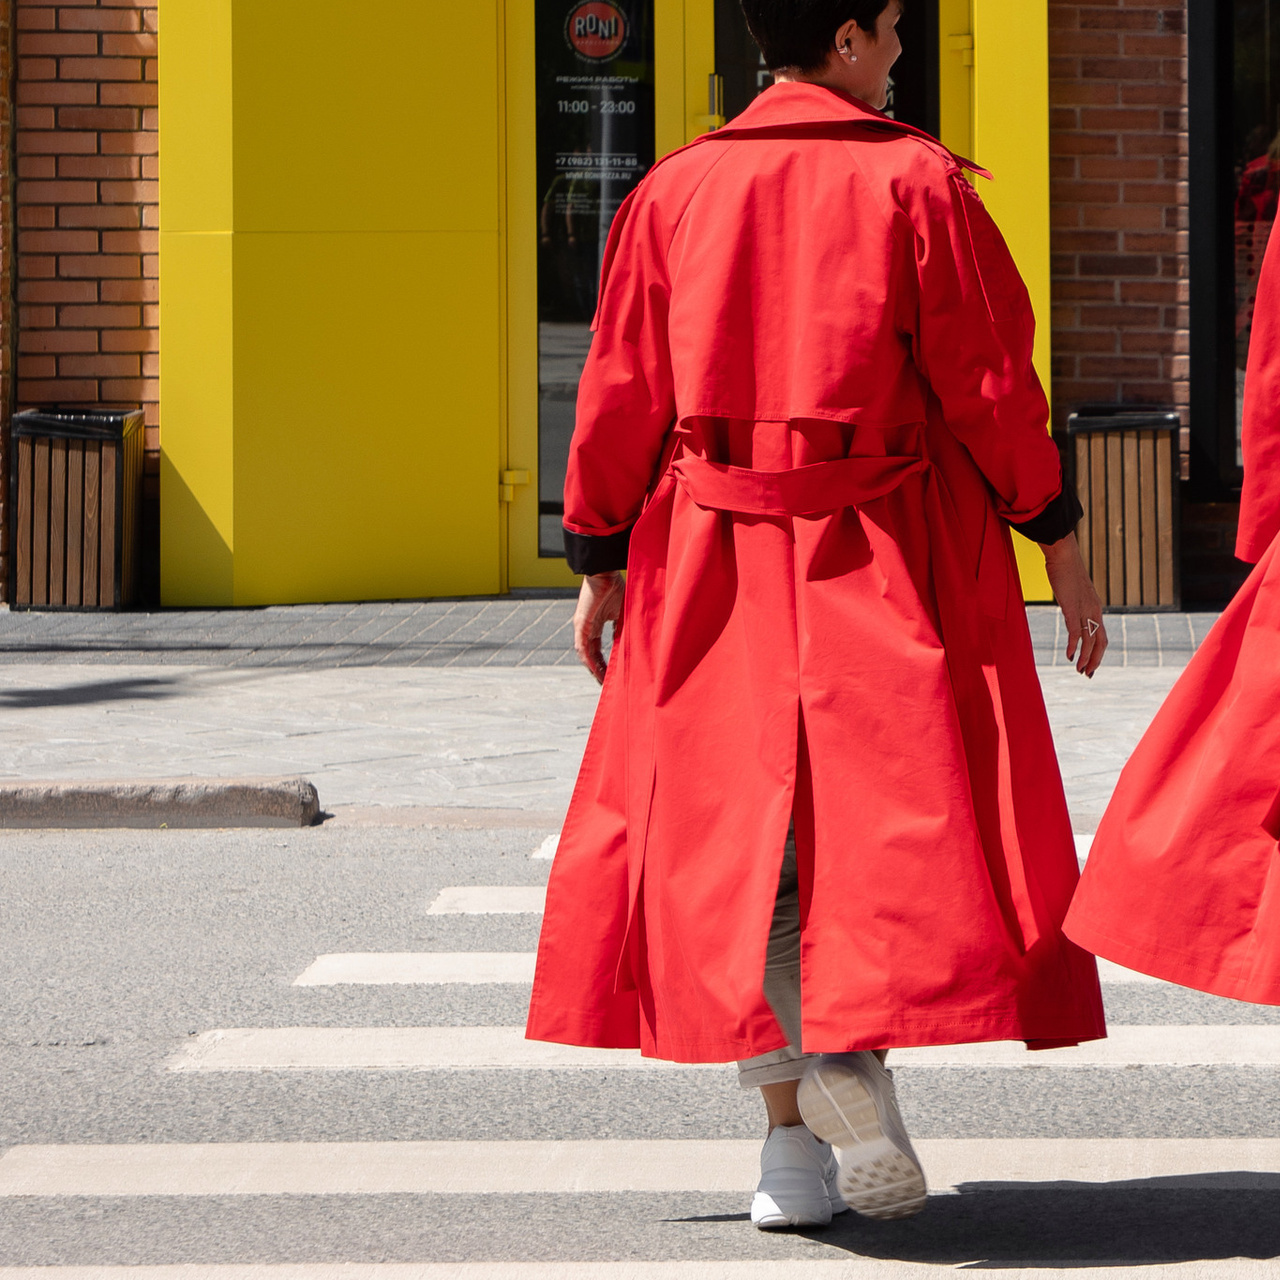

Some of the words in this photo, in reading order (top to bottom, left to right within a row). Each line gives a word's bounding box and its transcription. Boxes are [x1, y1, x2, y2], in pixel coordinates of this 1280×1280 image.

[575, 13, 616, 38] RONI
[557, 100, 589, 113] 11:00
[600, 100, 636, 114] 23:00
[555, 157, 567, 166] +7
